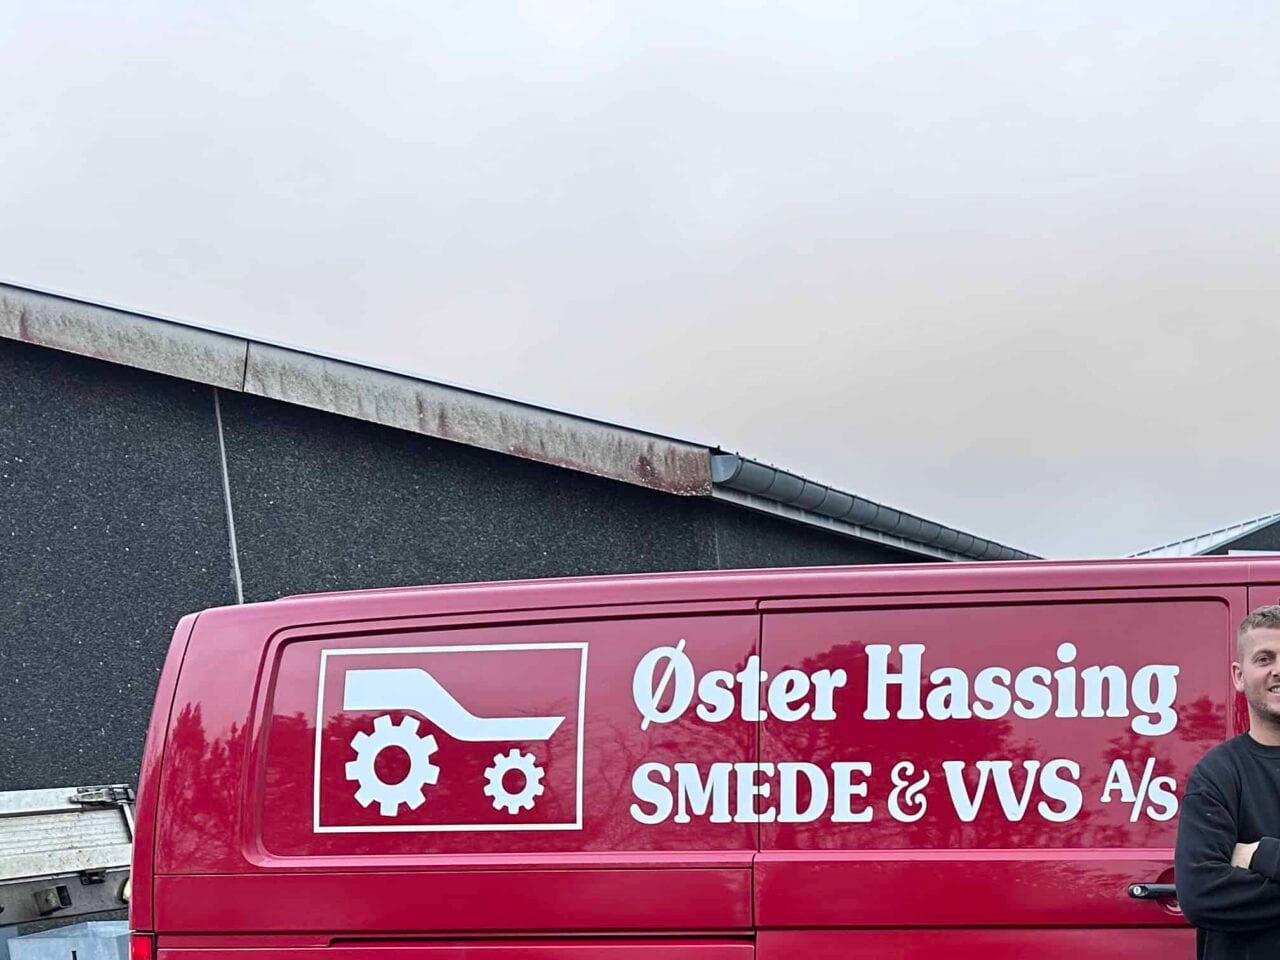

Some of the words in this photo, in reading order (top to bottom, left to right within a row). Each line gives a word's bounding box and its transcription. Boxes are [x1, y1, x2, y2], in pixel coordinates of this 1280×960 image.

[632, 638, 848, 731] Øster
[863, 642, 1181, 737] Hassing
[630, 761, 874, 825] SMEDE
[888, 760, 930, 823] &
[943, 758, 1083, 823] VVS
